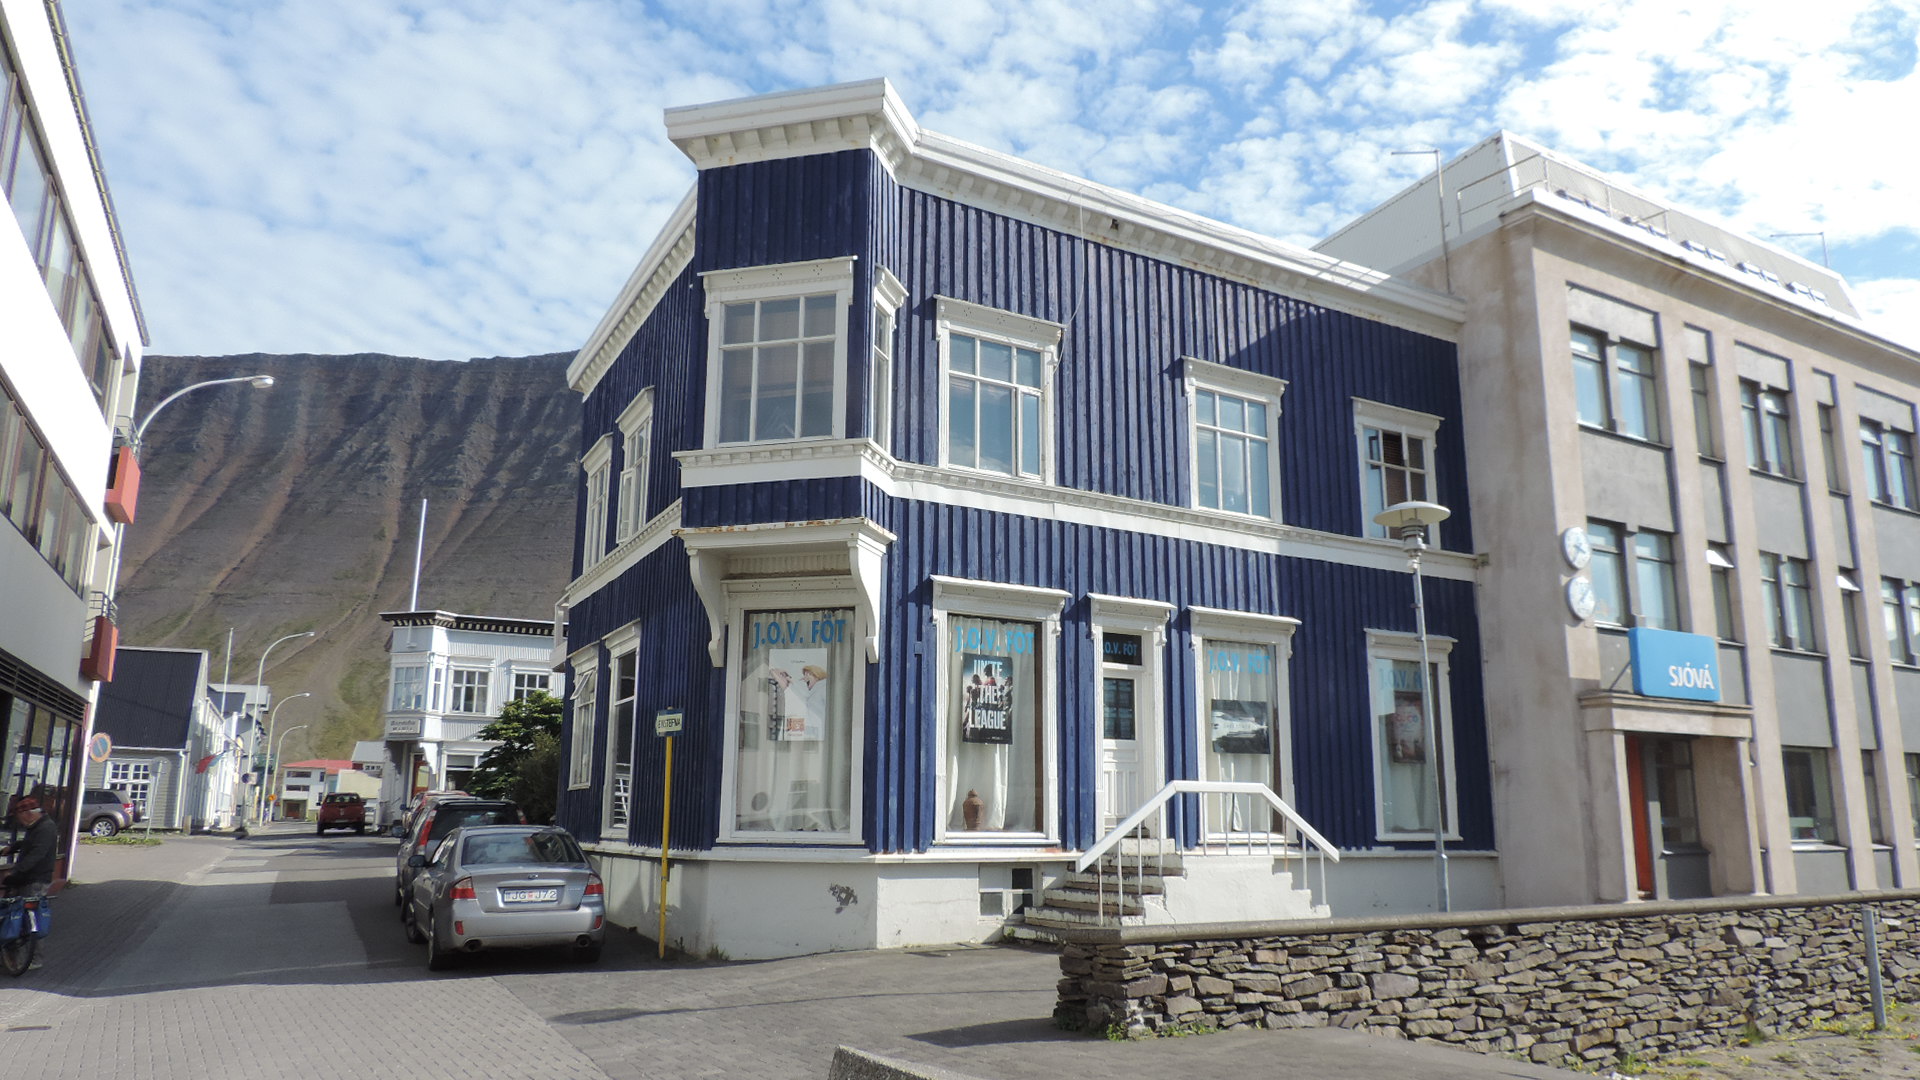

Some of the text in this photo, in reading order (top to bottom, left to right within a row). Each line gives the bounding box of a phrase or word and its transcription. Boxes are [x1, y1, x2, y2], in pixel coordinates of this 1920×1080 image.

[753, 613, 846, 649] J.O.V. FÖT
[955, 625, 1035, 655] J.O.V. FÖT
[973, 659, 1003, 678] UNTE
[1208, 649, 1243, 673] J.O.V.
[1668, 661, 1716, 690] SJÓVÁ
[969, 708, 1007, 730] LEAGUE
